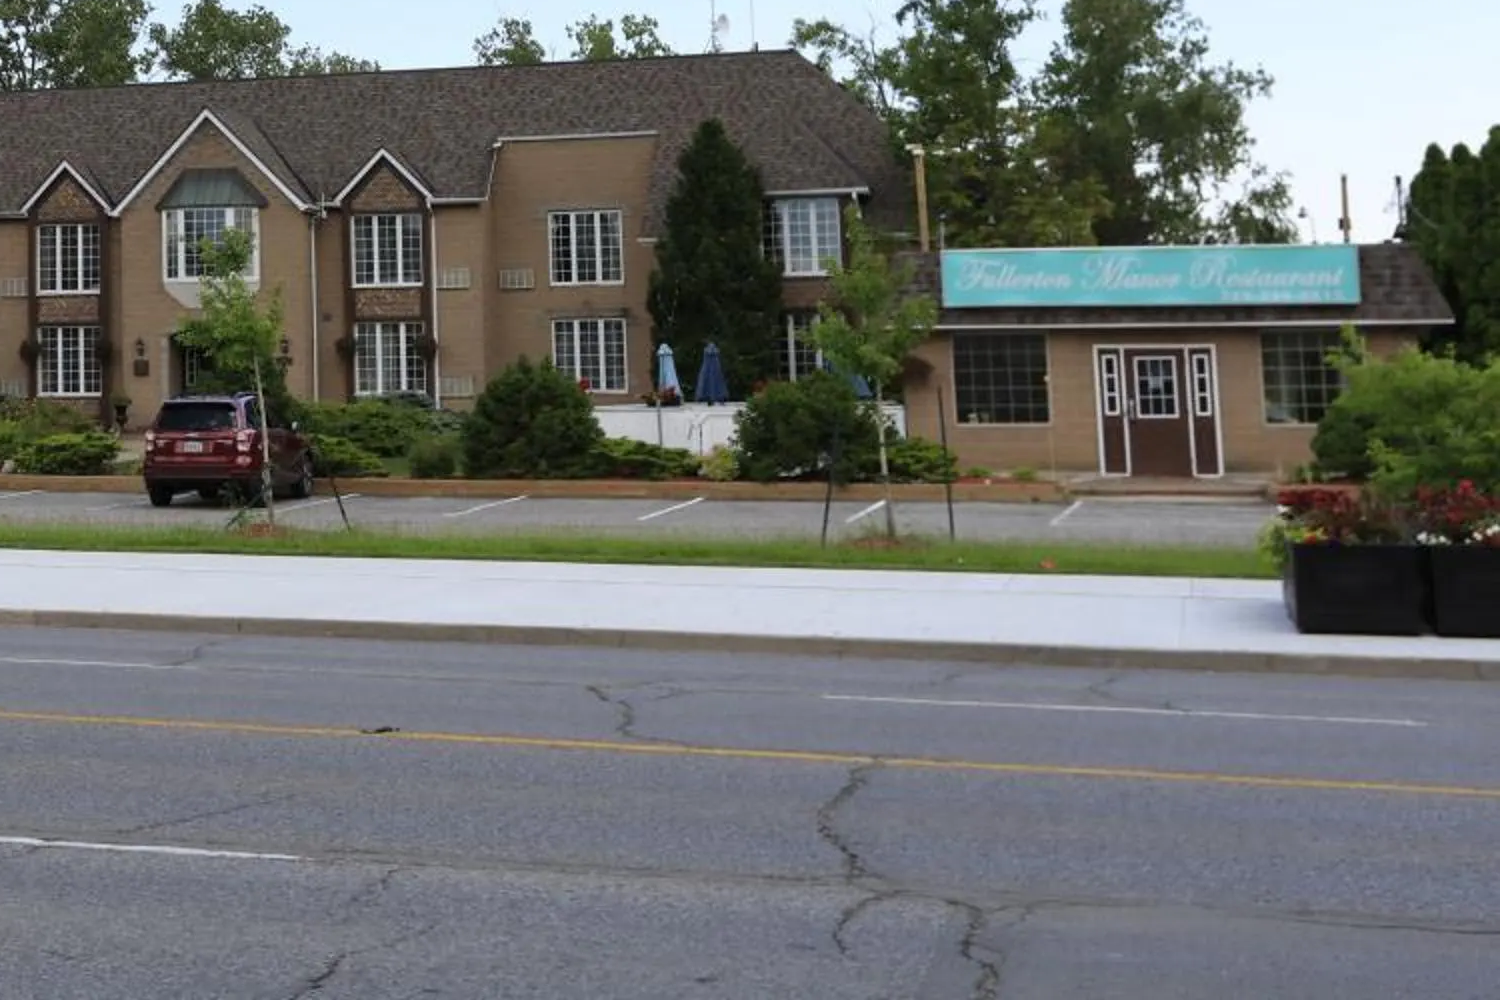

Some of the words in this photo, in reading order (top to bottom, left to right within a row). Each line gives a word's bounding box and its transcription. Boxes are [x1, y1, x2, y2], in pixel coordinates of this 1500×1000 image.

[956, 257, 1072, 290] Fullerton
[1081, 253, 1181, 290] Manor
[1189, 252, 1345, 288] Restaurant
